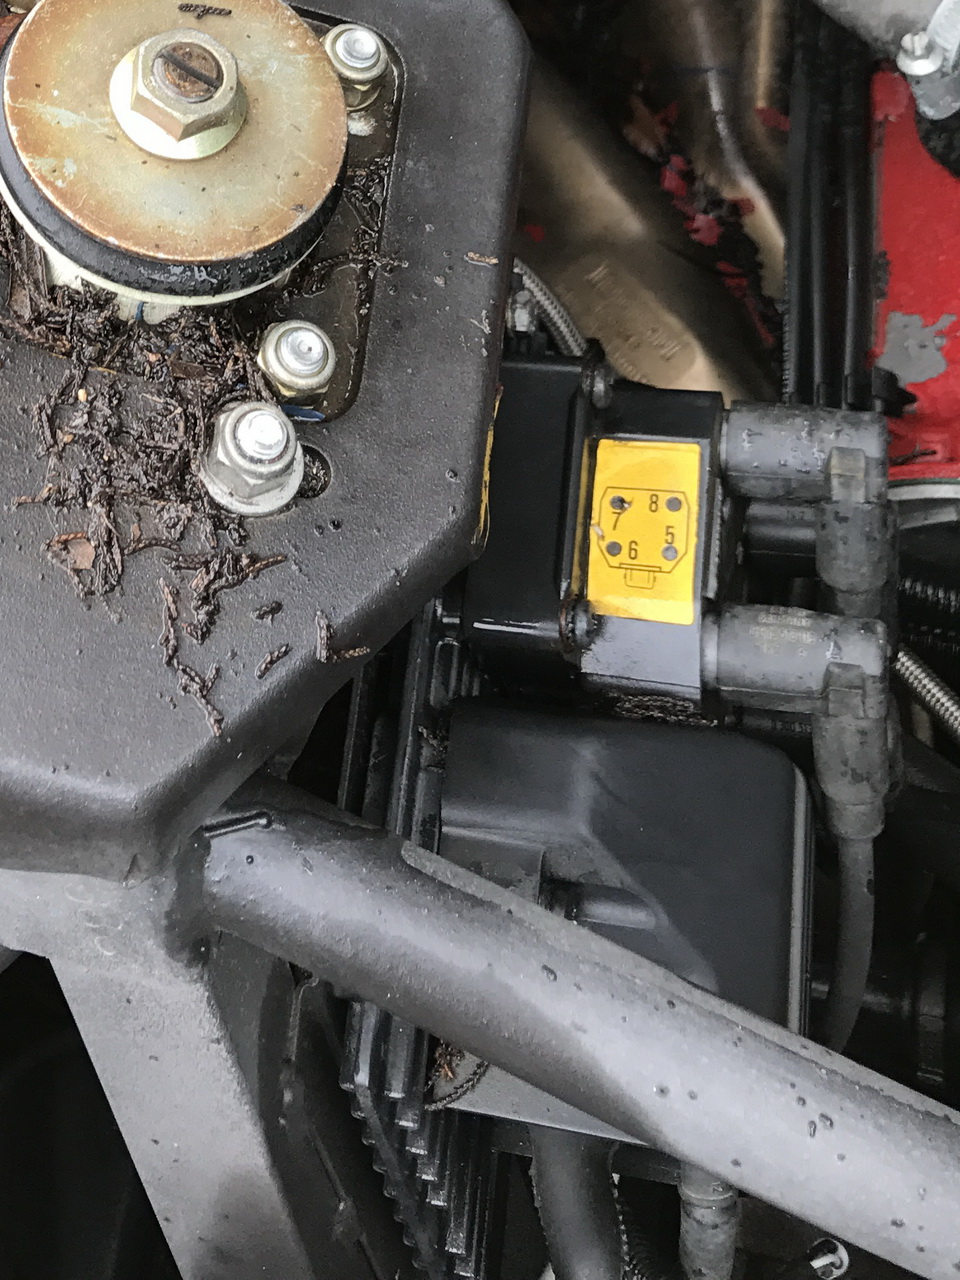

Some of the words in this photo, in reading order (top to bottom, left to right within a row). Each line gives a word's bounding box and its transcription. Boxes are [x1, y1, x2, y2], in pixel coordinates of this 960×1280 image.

[648, 493, 659, 513] 8
[611, 512, 622, 531] 7
[664, 525, 675, 545] 5
[628, 540, 639, 560] 6
